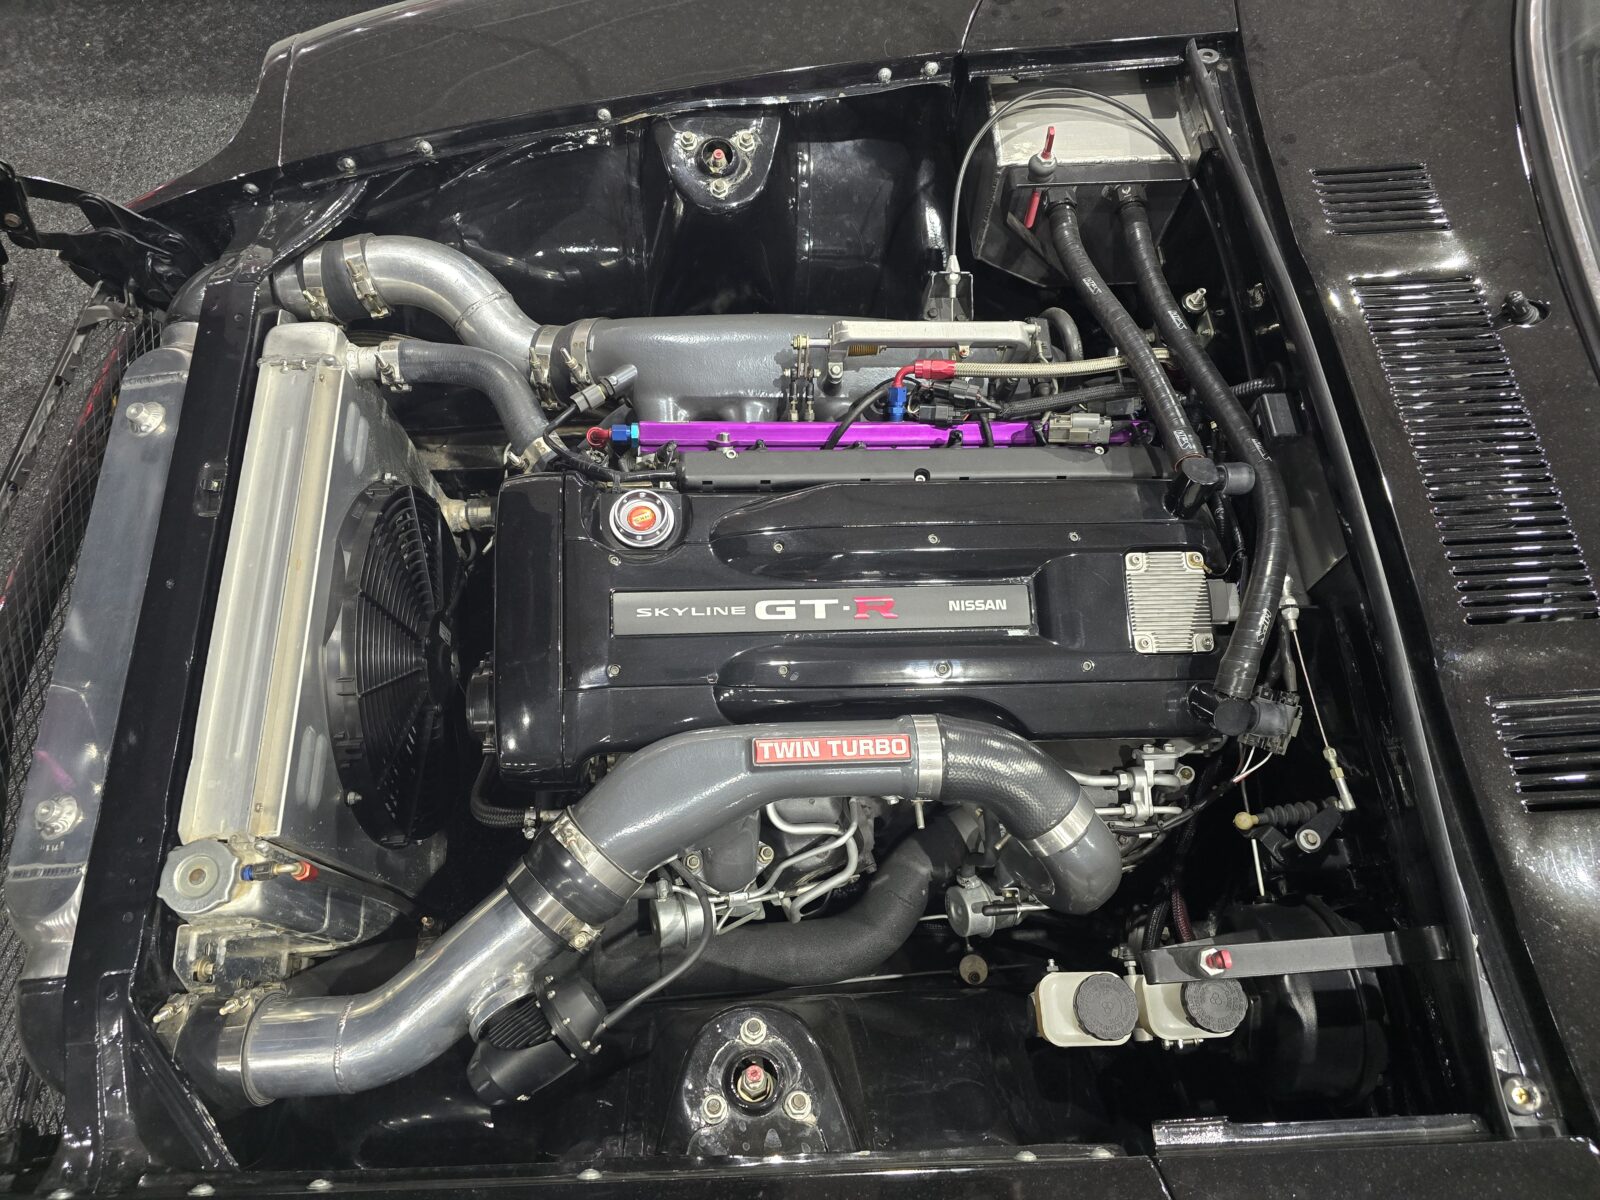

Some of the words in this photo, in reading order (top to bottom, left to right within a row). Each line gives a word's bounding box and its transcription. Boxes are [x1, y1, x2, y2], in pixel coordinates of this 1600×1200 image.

[636, 605, 746, 617] SKYLINE
[754, 596, 899, 620] GT-R
[948, 599, 1008, 612] NISSAN
[758, 740, 820, 759] TWIN
[827, 738, 907, 757] TURBO
